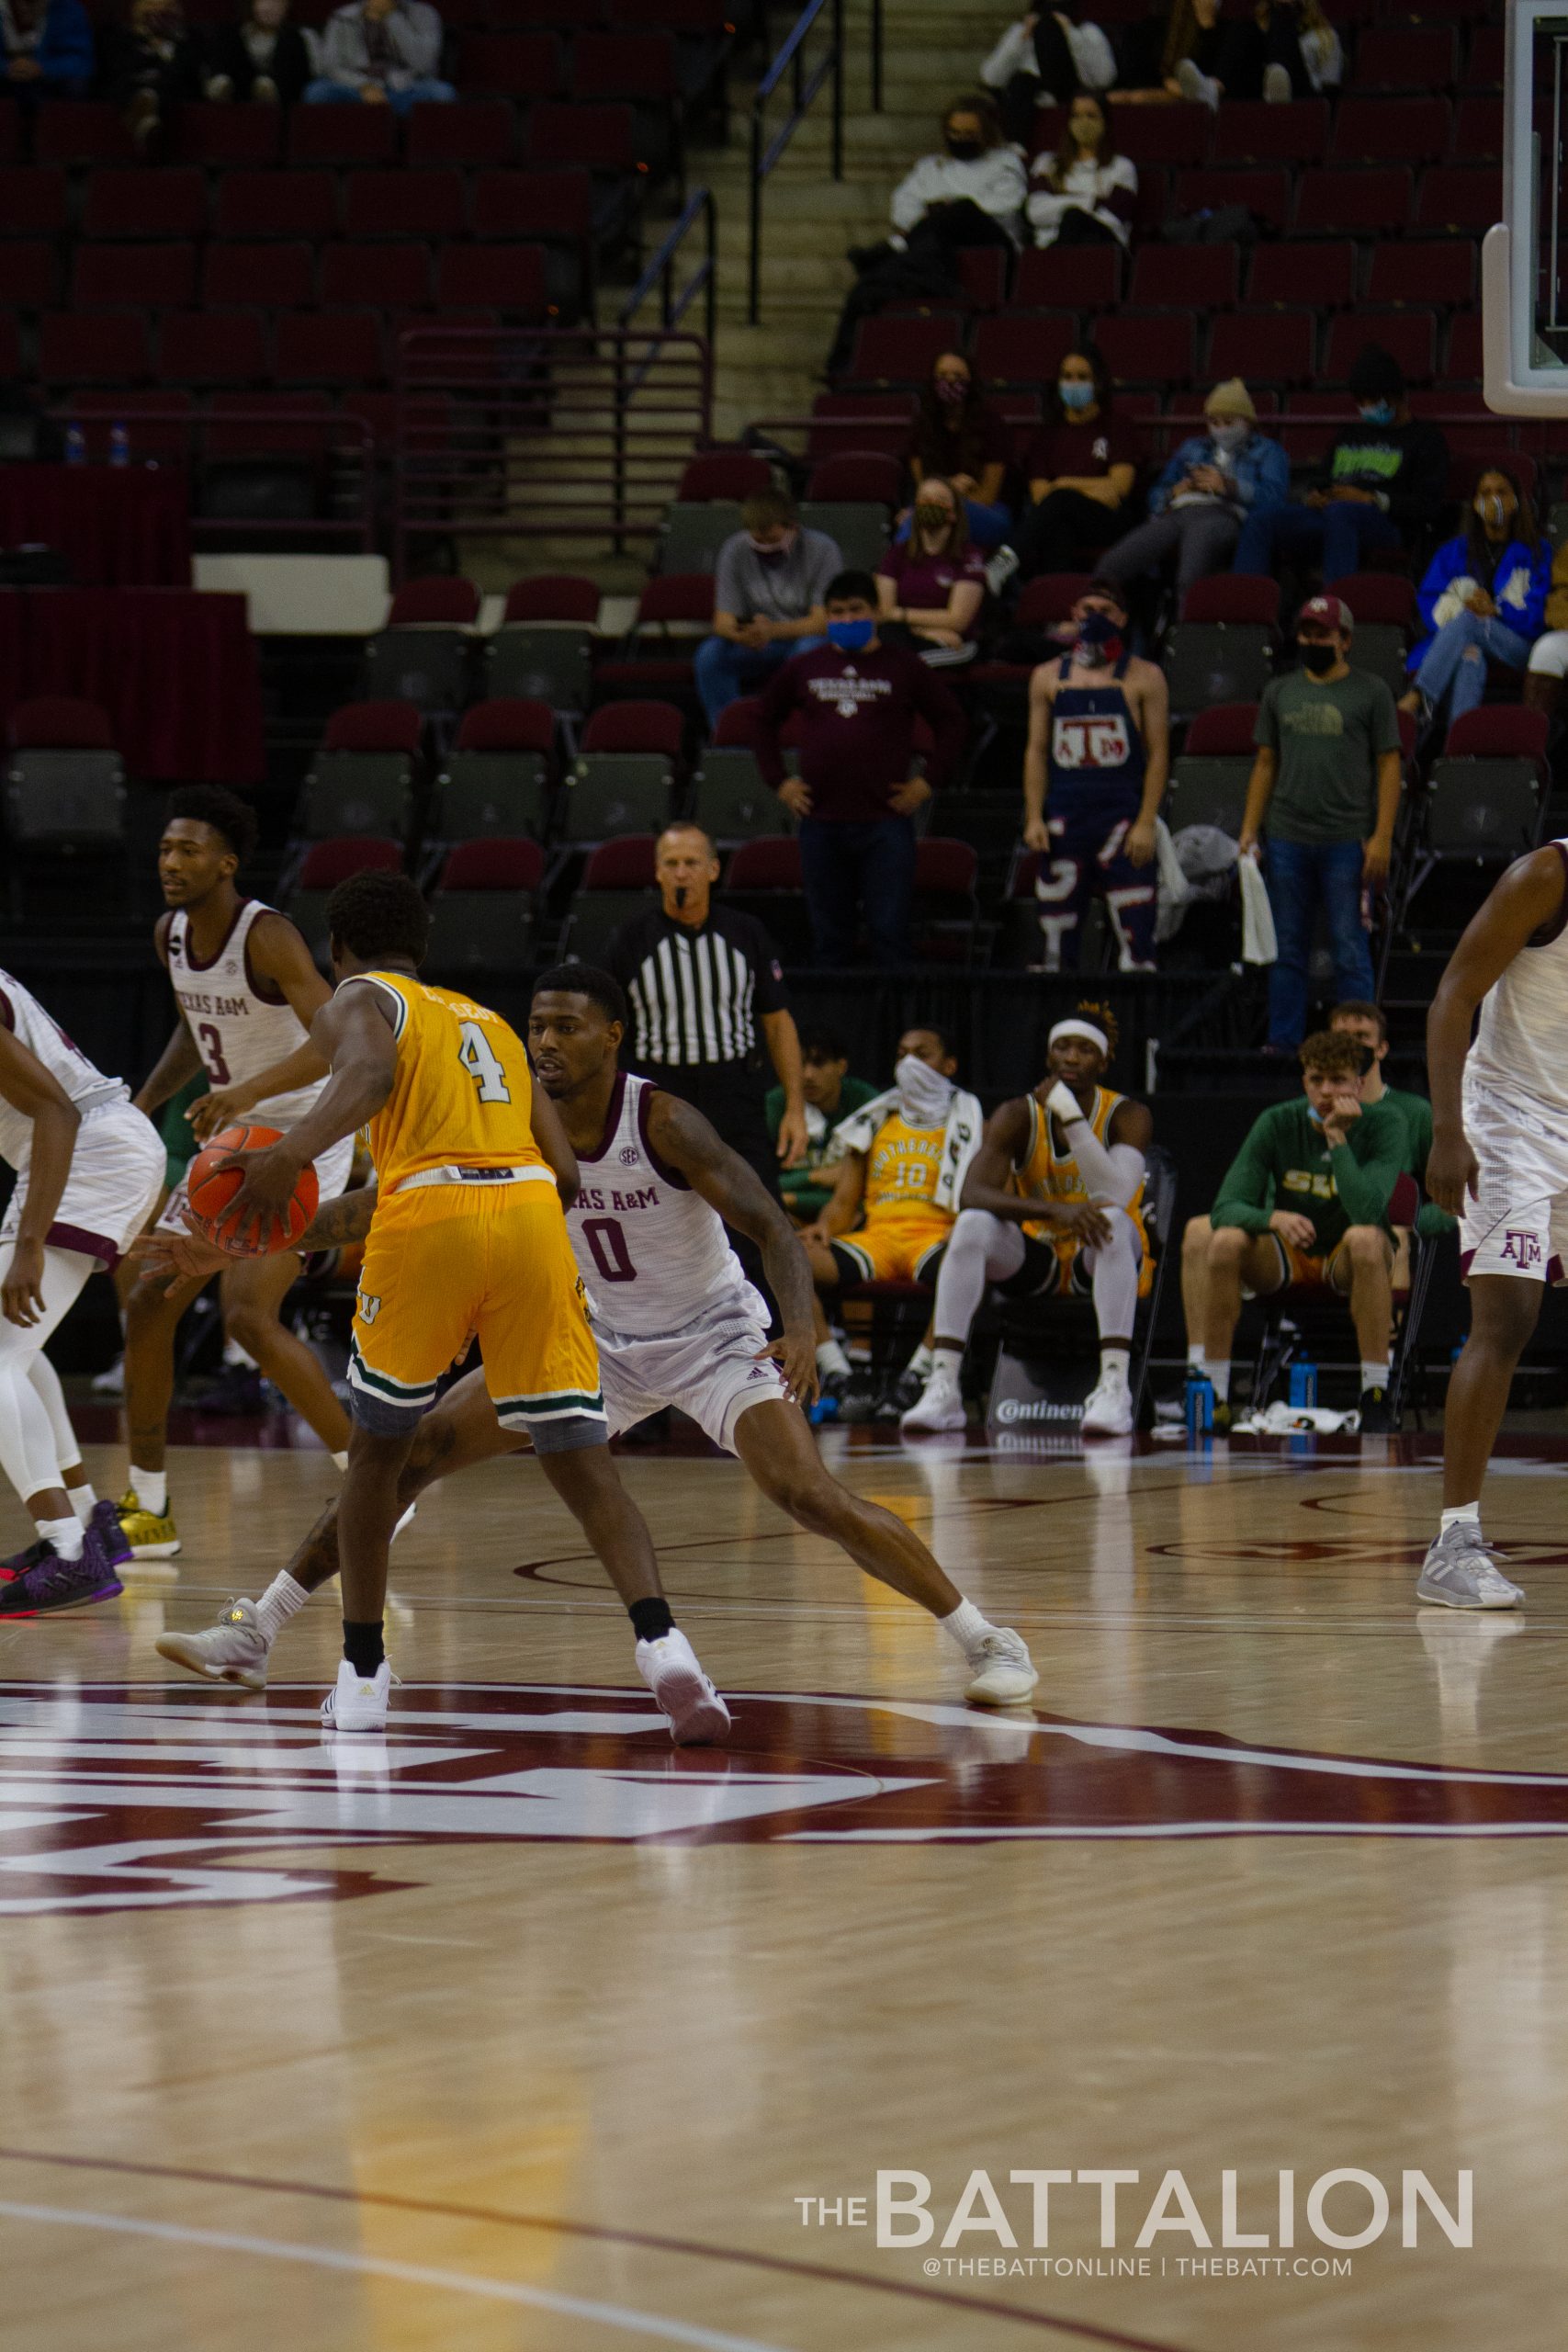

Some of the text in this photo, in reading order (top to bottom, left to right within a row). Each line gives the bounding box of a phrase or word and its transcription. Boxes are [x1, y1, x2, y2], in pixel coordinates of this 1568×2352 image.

[181, 991, 250, 1016] EXAS A&M
[199, 1023, 231, 1085] 3
[457, 1020, 512, 1104] 4
[622, 1150, 637, 1164] SEC
[895, 1160, 928, 1189] 10
[1281, 1169, 1338, 1200] SL
[612, 1187, 660, 1211] A&M
[581, 1217, 637, 1282] 0
